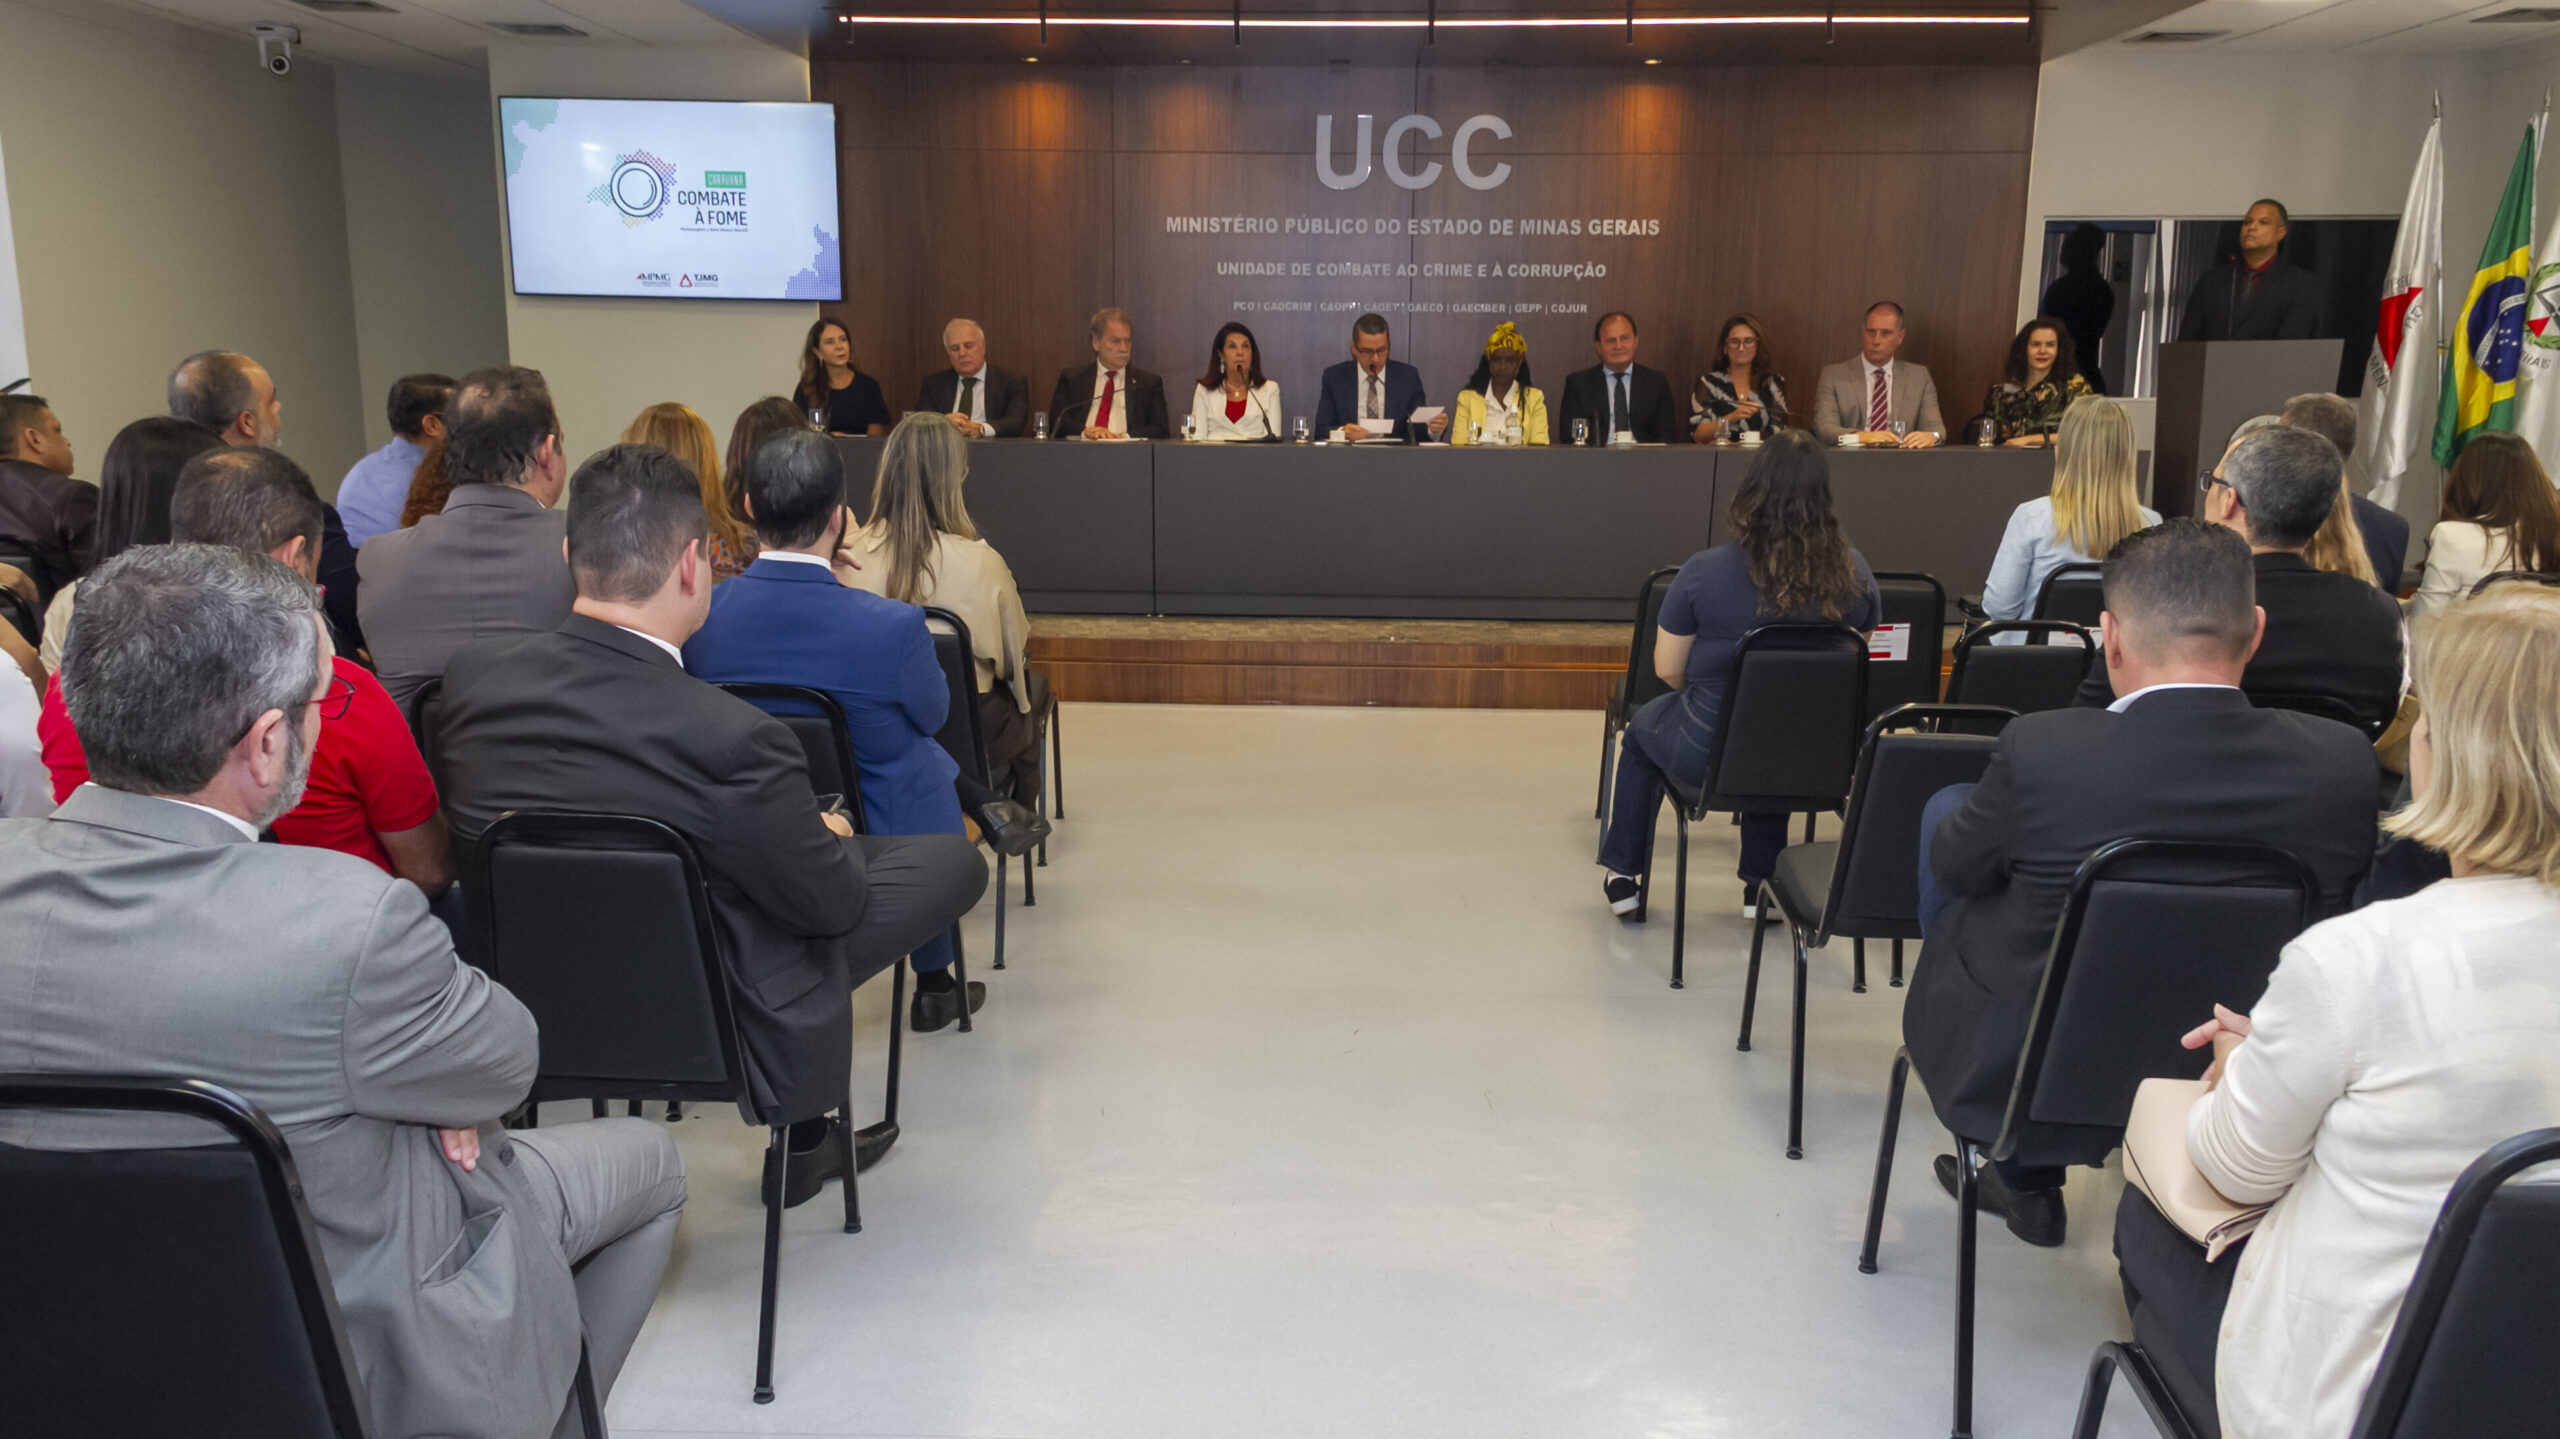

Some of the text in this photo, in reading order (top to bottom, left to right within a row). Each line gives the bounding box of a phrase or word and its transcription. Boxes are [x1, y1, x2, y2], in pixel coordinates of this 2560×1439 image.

[1315, 114, 1513, 190] UCC
[708, 174, 744, 185] CARAVANA
[677, 190, 747, 207] COMBATE
[694, 206, 748, 226] À FOME
[1166, 214, 1660, 236] MINISTÉRIO PÚBLICO DO ESTADO DE MINAS GERAIS
[1217, 261, 1607, 280] UNIDADE DE COMBATE AO CRIME E À CORRUPÇÃO
[1233, 302, 1255, 311] PCO
[1407, 303, 1444, 313] GAECO
[1514, 303, 1542, 313] GEPP
[1551, 303, 1587, 314] COJUR
